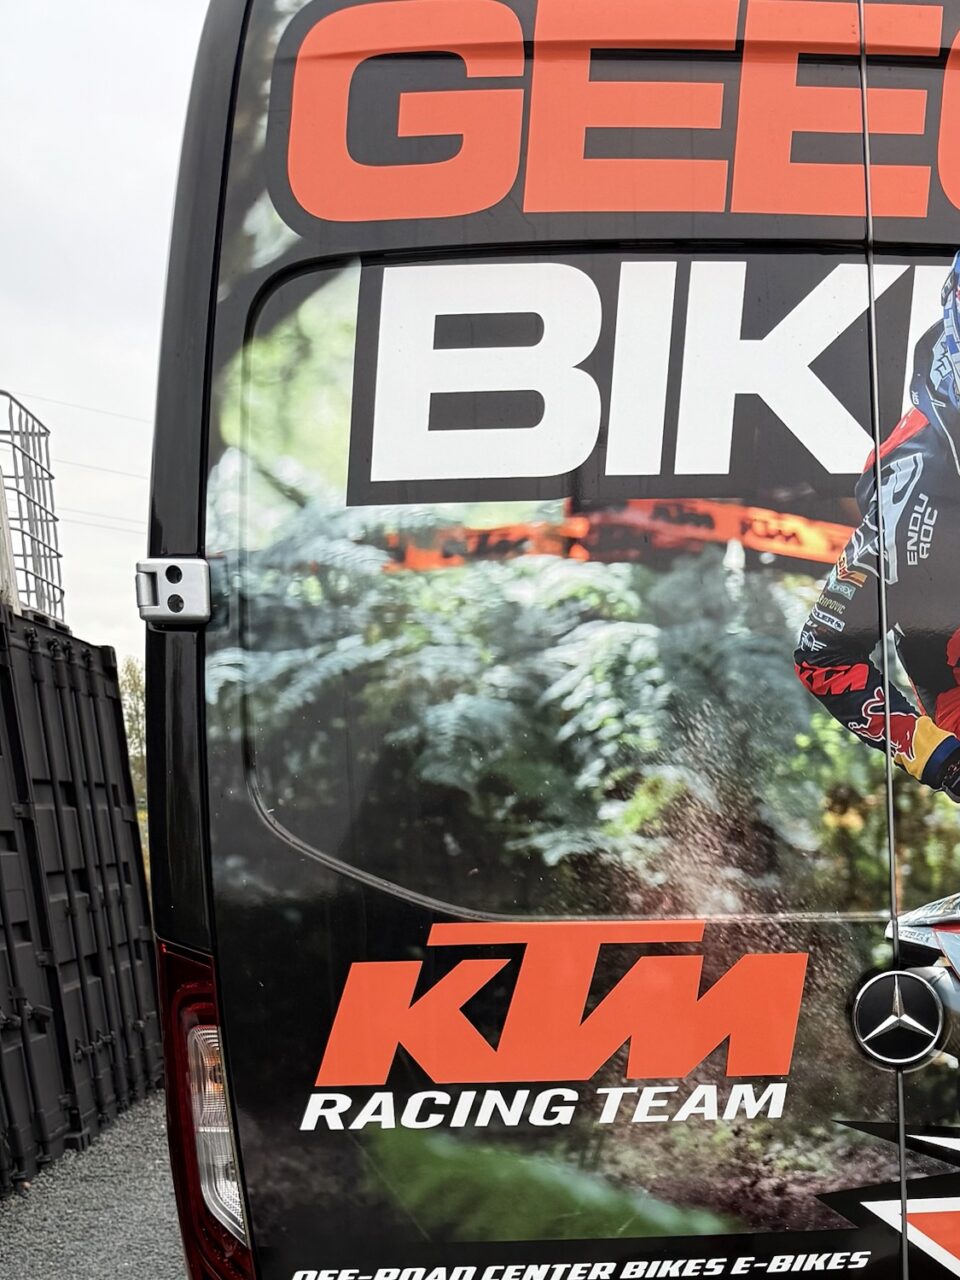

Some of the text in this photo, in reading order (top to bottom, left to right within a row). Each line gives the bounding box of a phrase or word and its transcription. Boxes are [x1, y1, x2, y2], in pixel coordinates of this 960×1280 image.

[315, 920, 809, 1086] KTM
[300, 1083, 788, 1131] RACING TEAM
[620, 1256, 724, 1280] BIKES
[730, 1251, 872, 1274] E-BIKES
